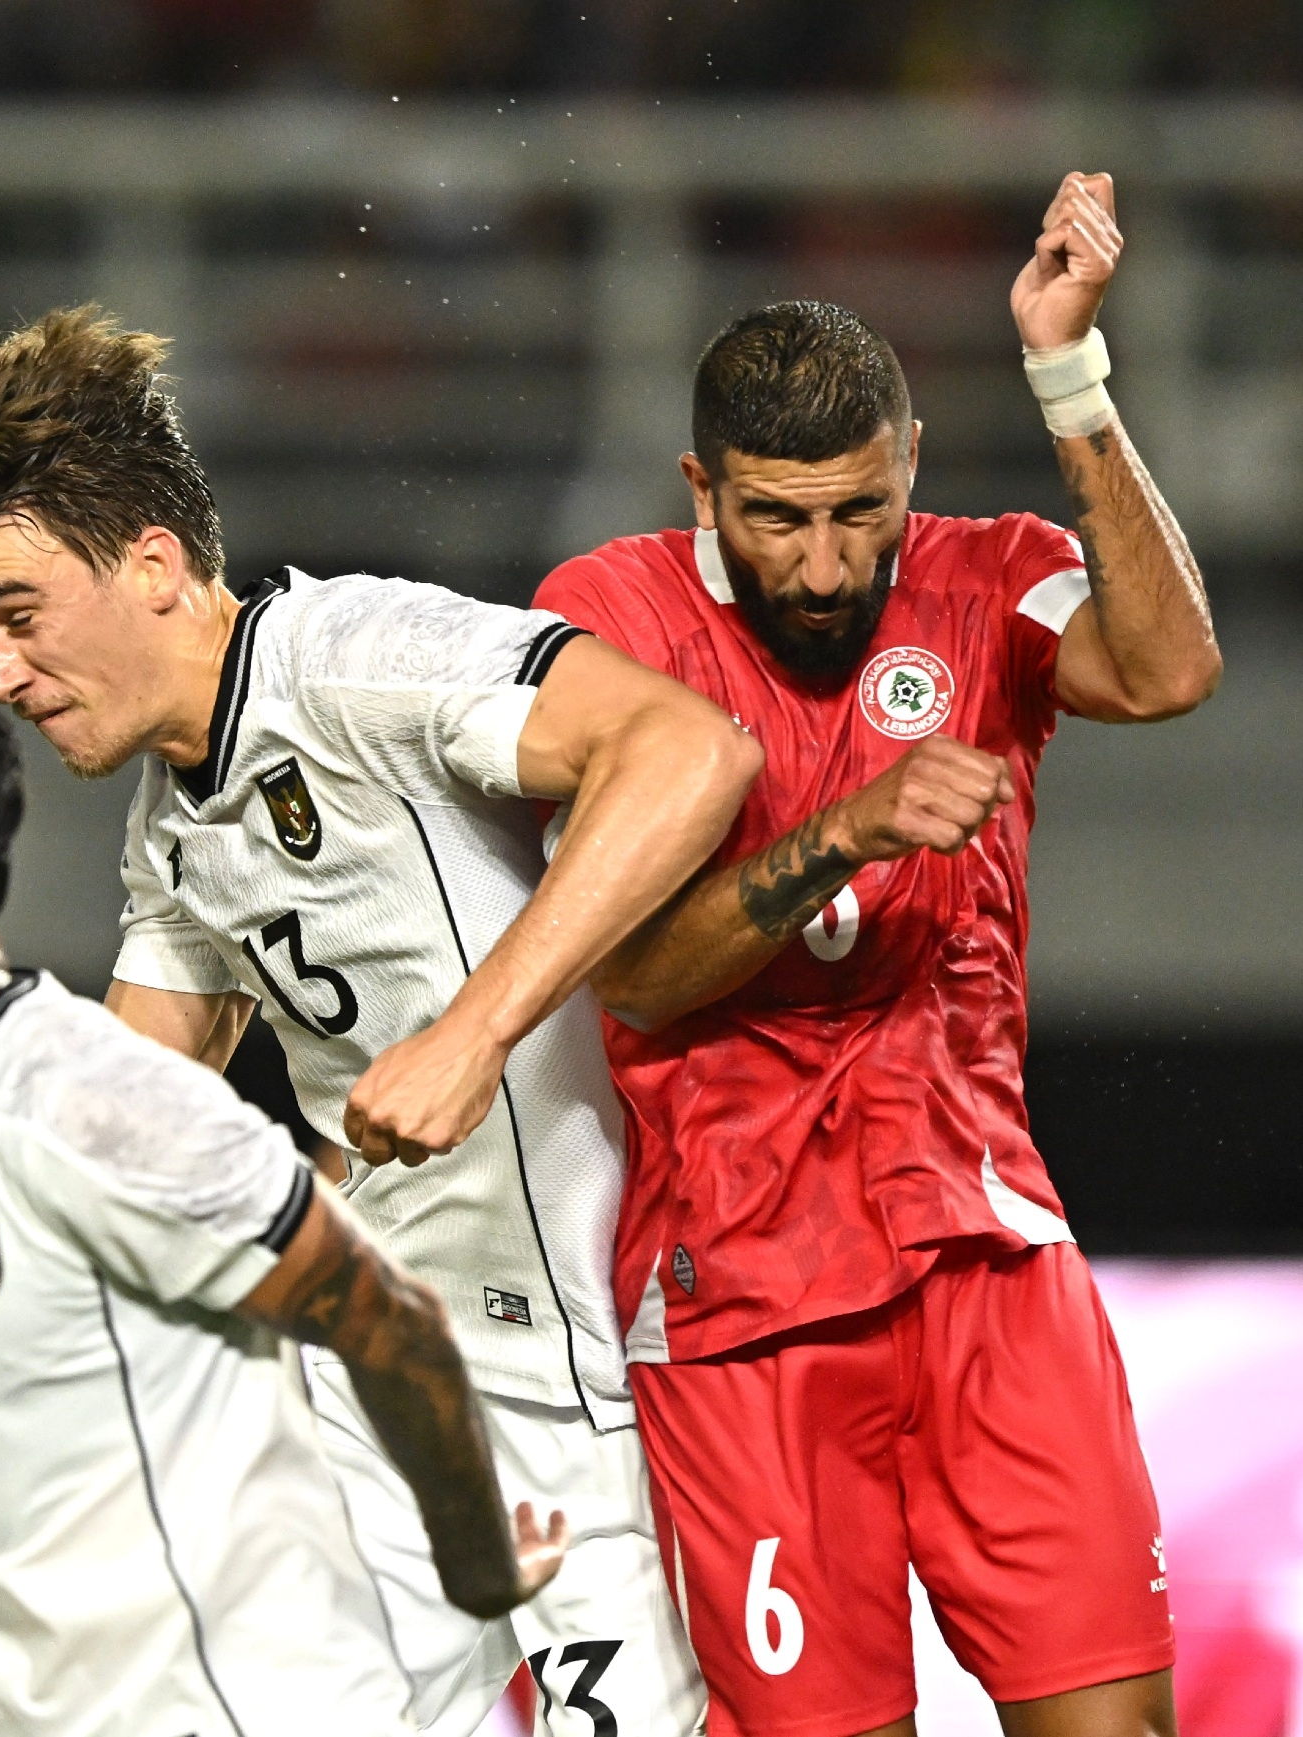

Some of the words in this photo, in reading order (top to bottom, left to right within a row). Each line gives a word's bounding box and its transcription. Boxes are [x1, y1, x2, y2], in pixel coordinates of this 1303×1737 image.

[882, 710, 942, 734] LEBANON
[262, 764, 292, 786] INDONESIA
[241, 908, 359, 1041] 13
[744, 1536, 805, 1676] 6
[526, 1639, 625, 1737] 13
